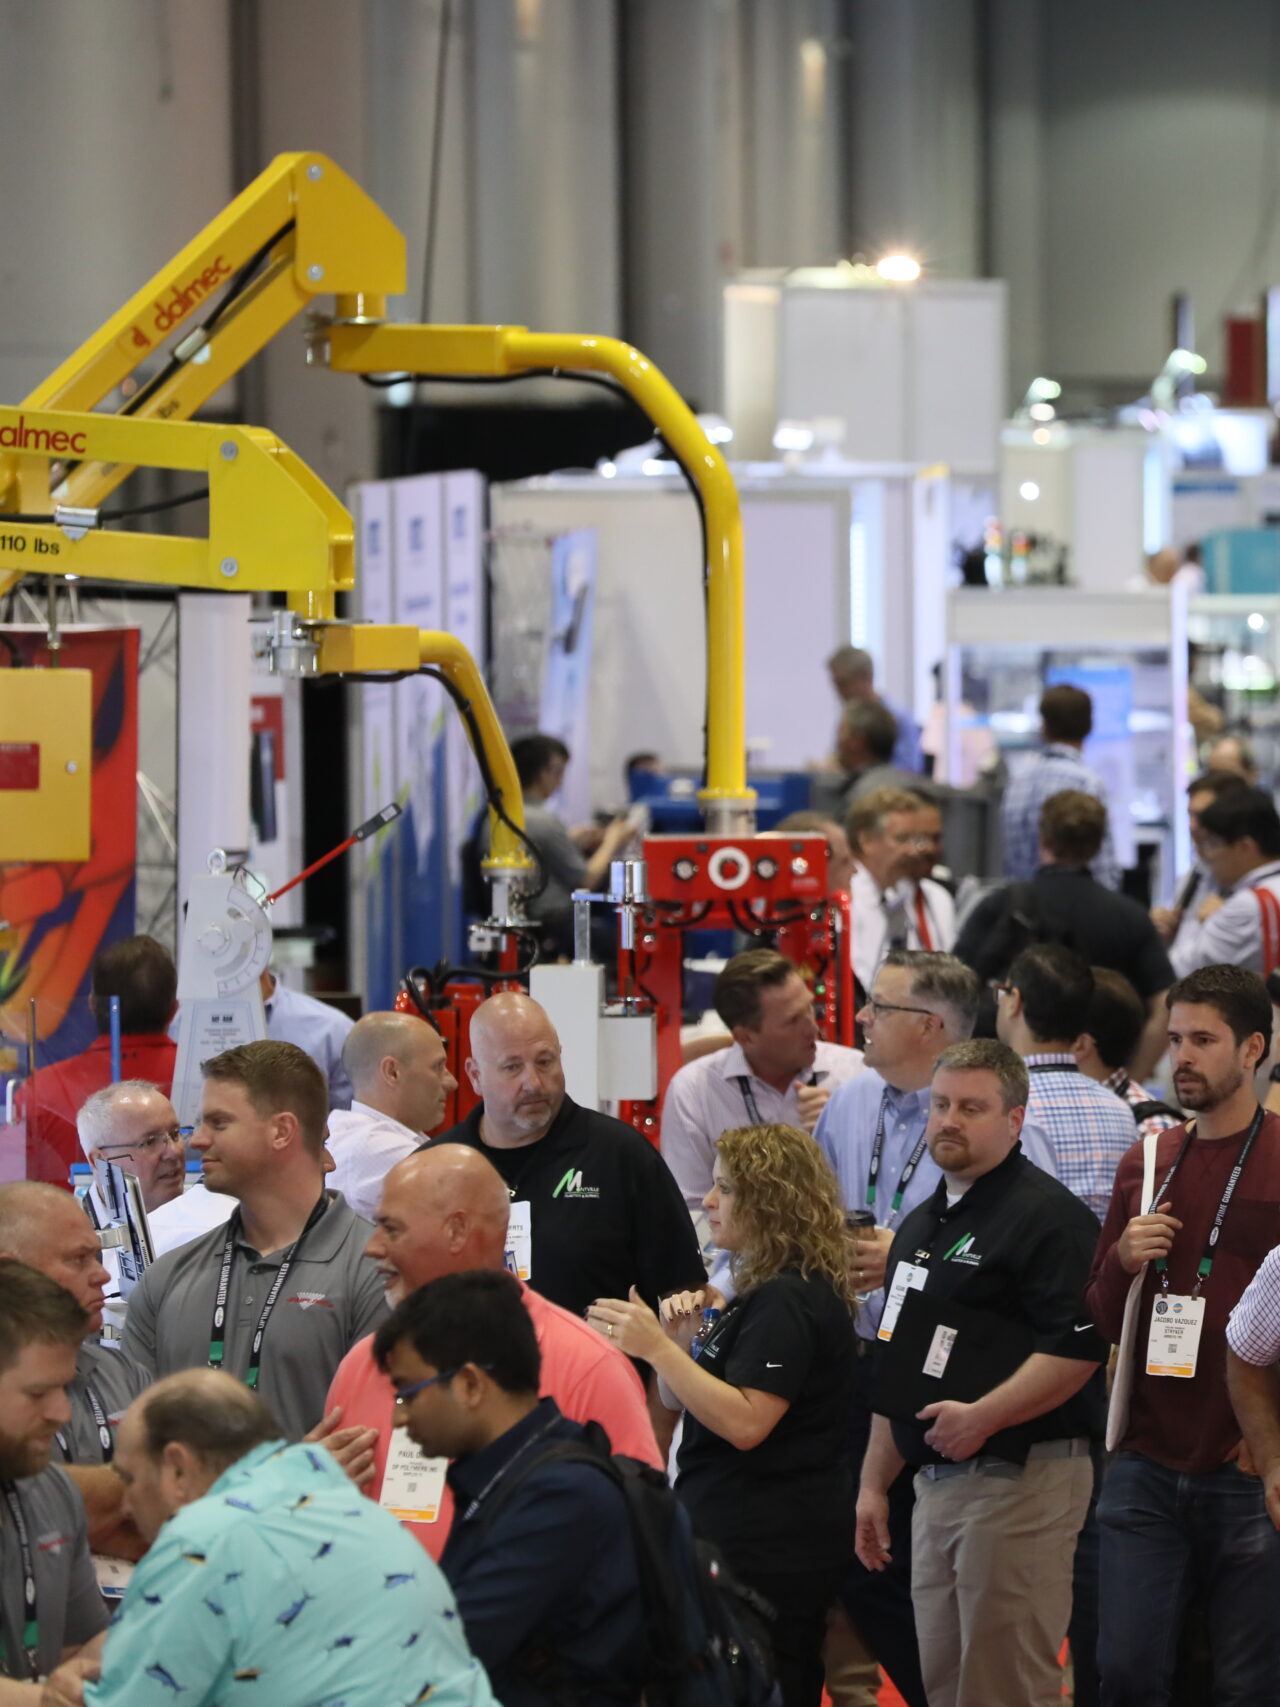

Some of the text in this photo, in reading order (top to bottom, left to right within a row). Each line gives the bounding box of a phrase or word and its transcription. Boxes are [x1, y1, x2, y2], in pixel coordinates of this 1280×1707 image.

[154, 255, 231, 332] dalmec
[34, 538, 60, 555] lbs
[1222, 1166, 1241, 1203] GUARANTEED
[217, 1265, 230, 1305] GUARANTEED
[267, 1263, 289, 1305] GUARANTEED
